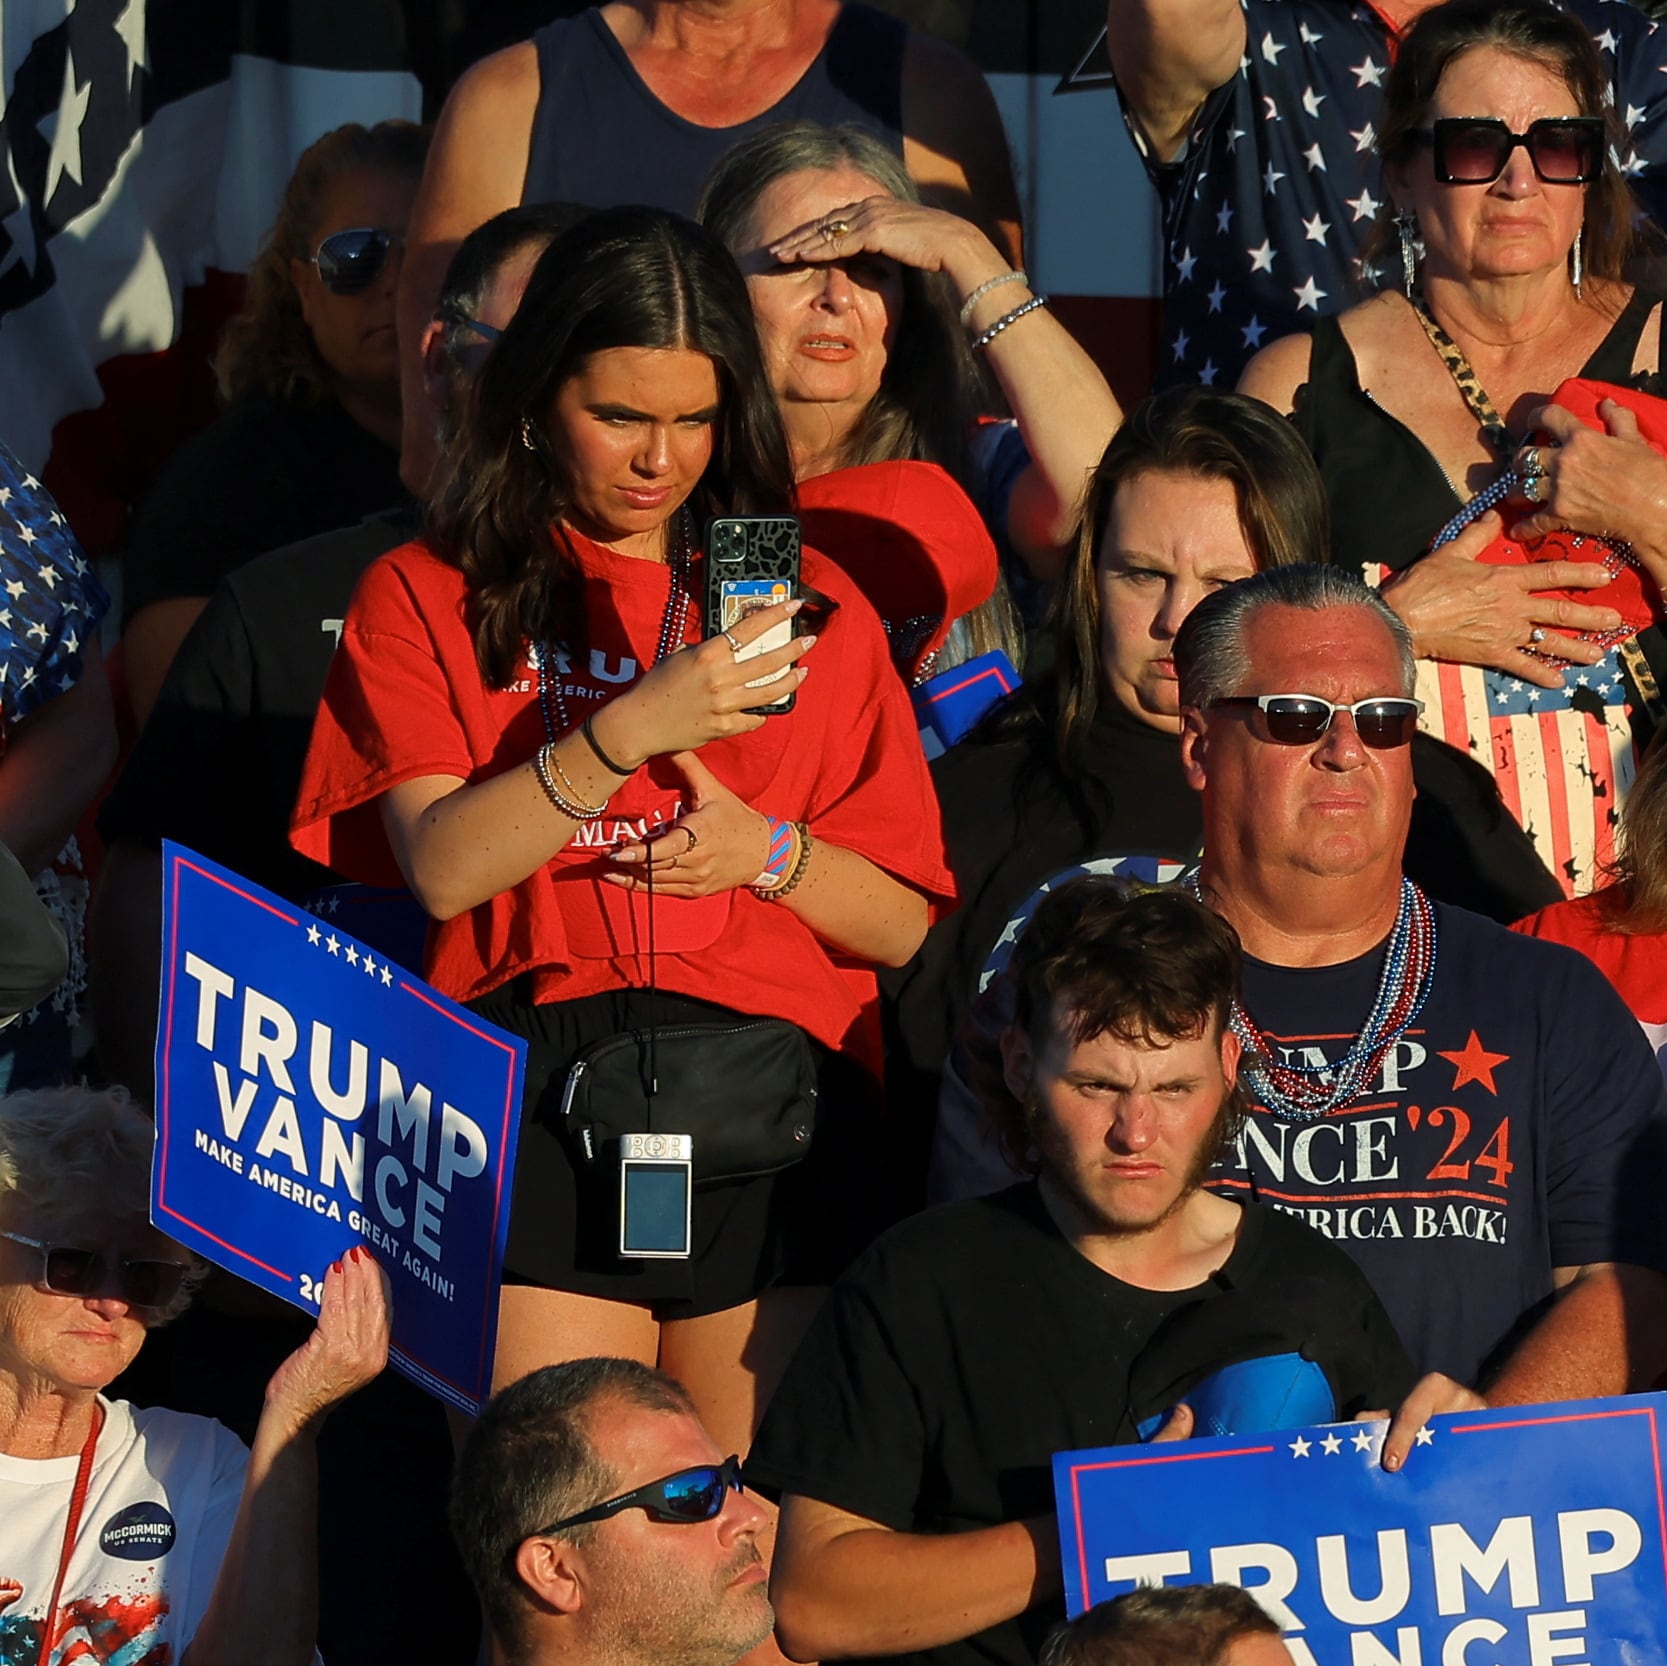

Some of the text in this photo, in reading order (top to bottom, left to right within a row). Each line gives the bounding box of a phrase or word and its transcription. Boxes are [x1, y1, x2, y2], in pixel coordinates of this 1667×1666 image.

[183, 950, 488, 1190] TRUMP
[194, 1128, 455, 1302] MAKE AMERICA GREAT AGAIN!
[212, 1059, 447, 1261] VANCE
[1405, 1106, 1514, 1190] '24
[1413, 1206, 1509, 1245] BACK!
[1105, 1510, 1642, 1631] TRUMP
